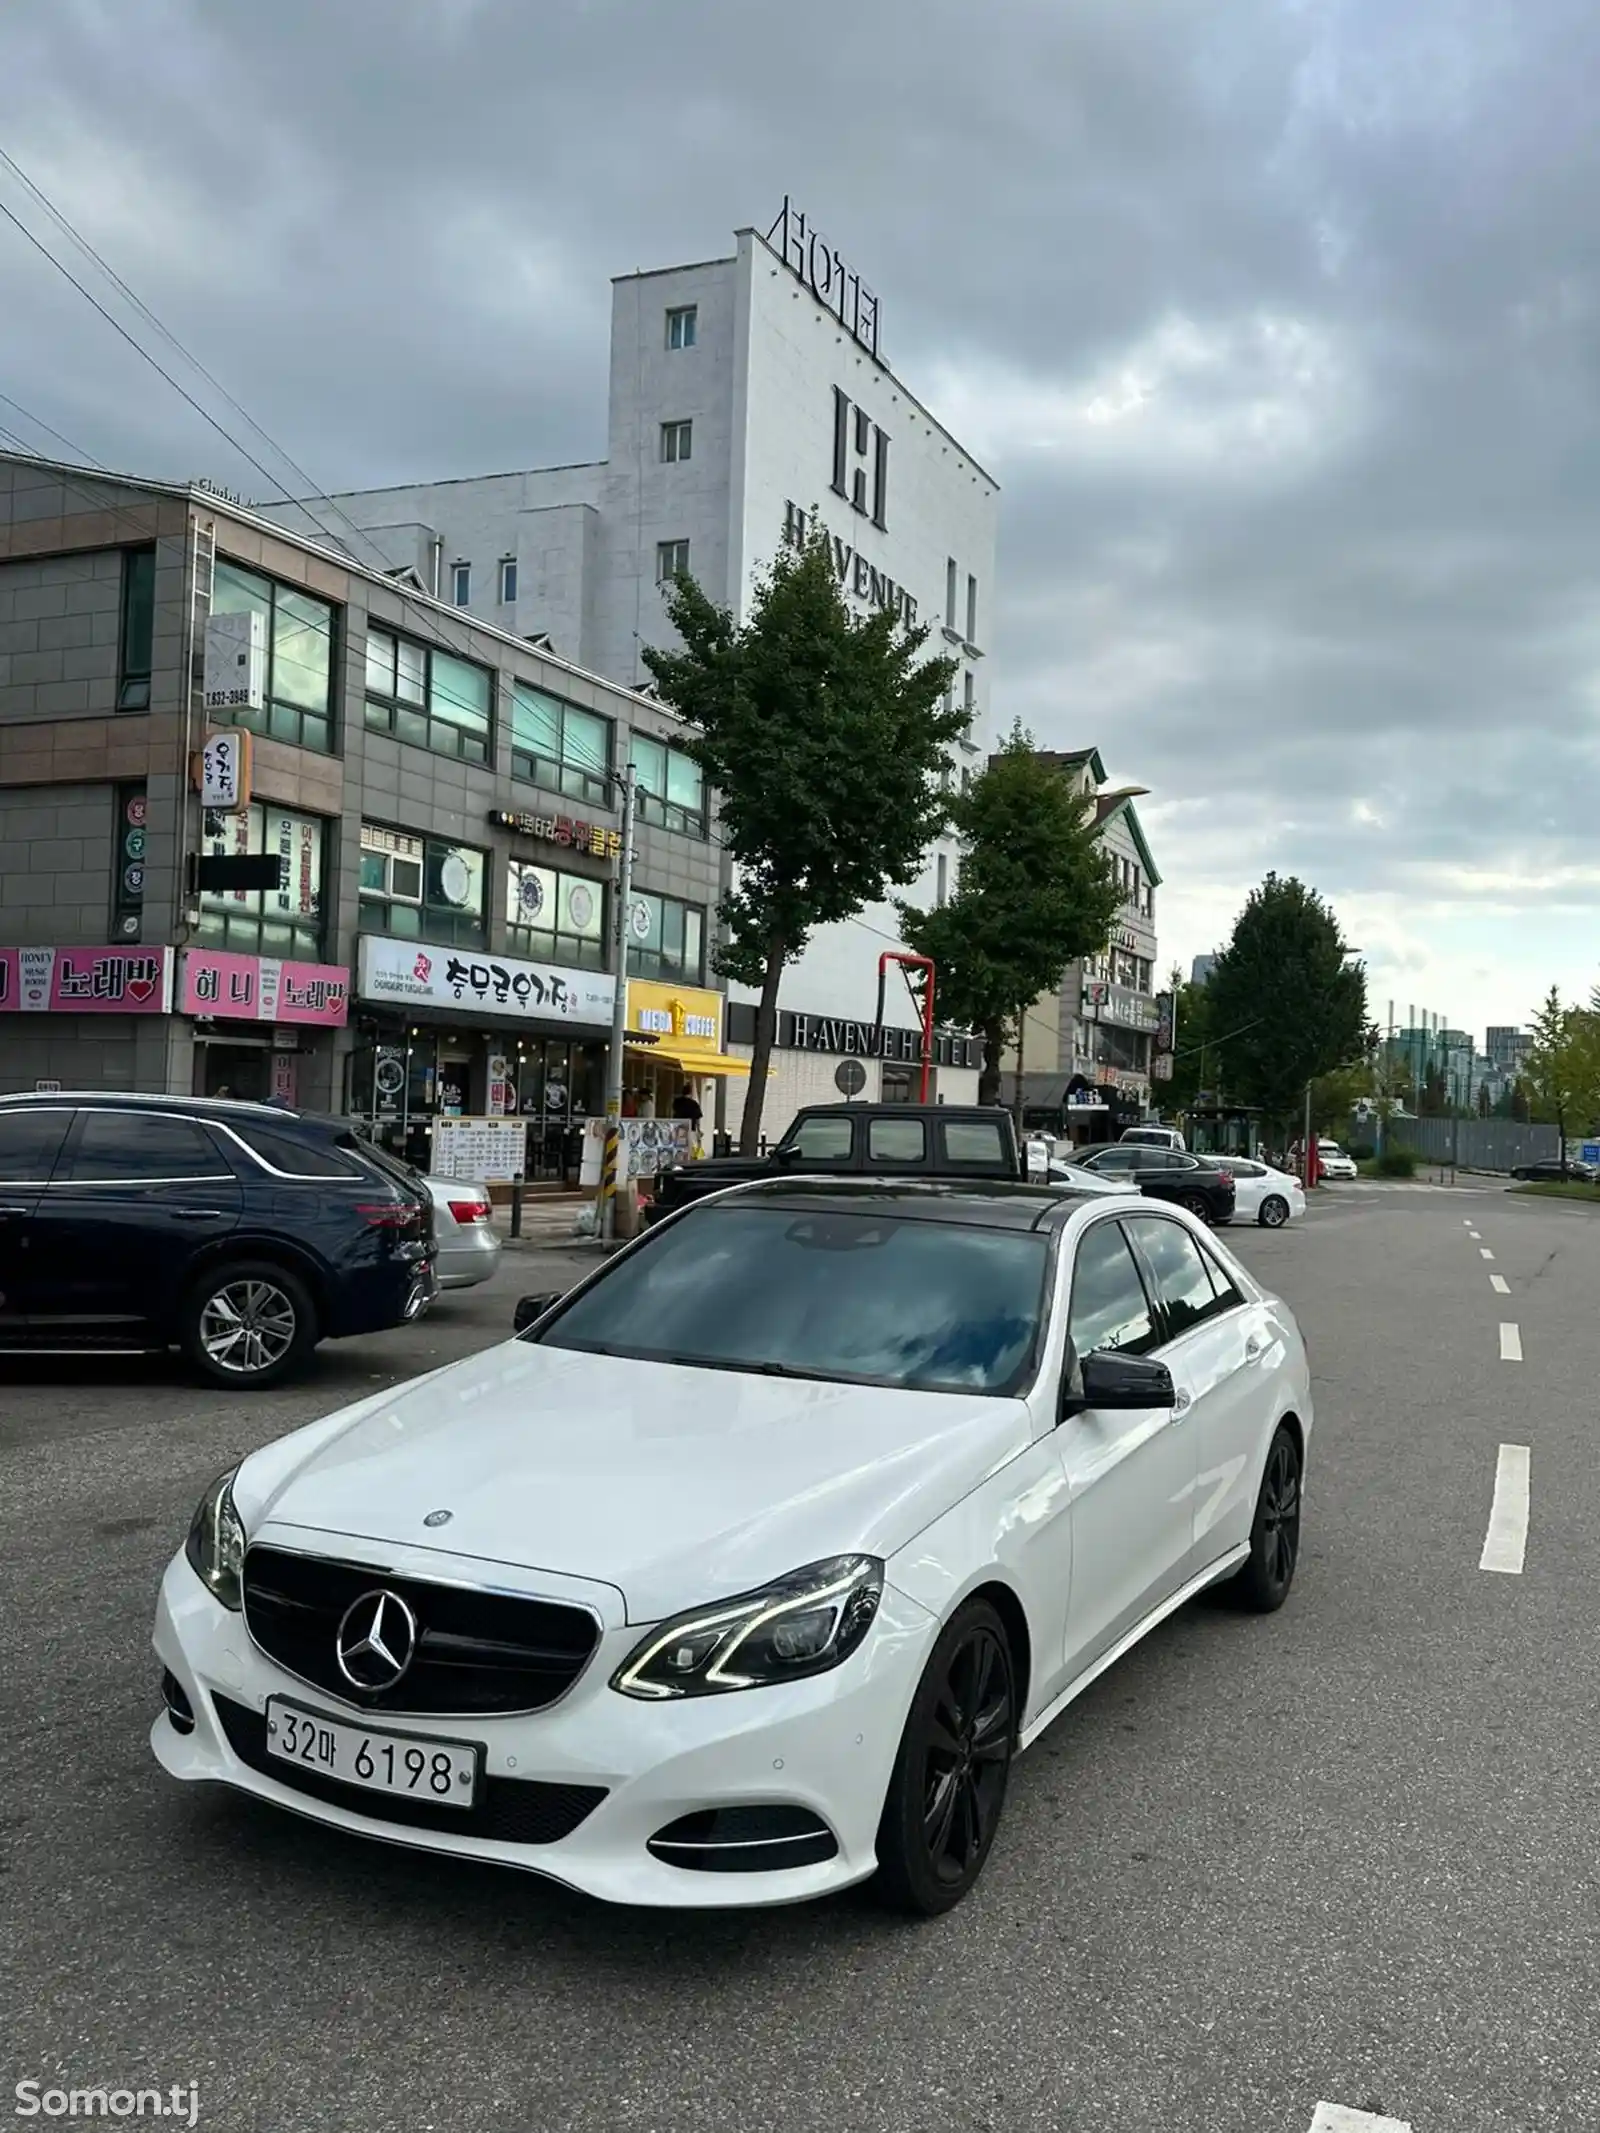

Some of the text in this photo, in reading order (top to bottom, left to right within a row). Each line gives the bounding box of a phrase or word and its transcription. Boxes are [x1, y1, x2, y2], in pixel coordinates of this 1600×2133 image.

[781, 194, 890, 370] HOTEL
[830, 383, 893, 533] H
[282, 1713, 452, 1794] 32마 6198
